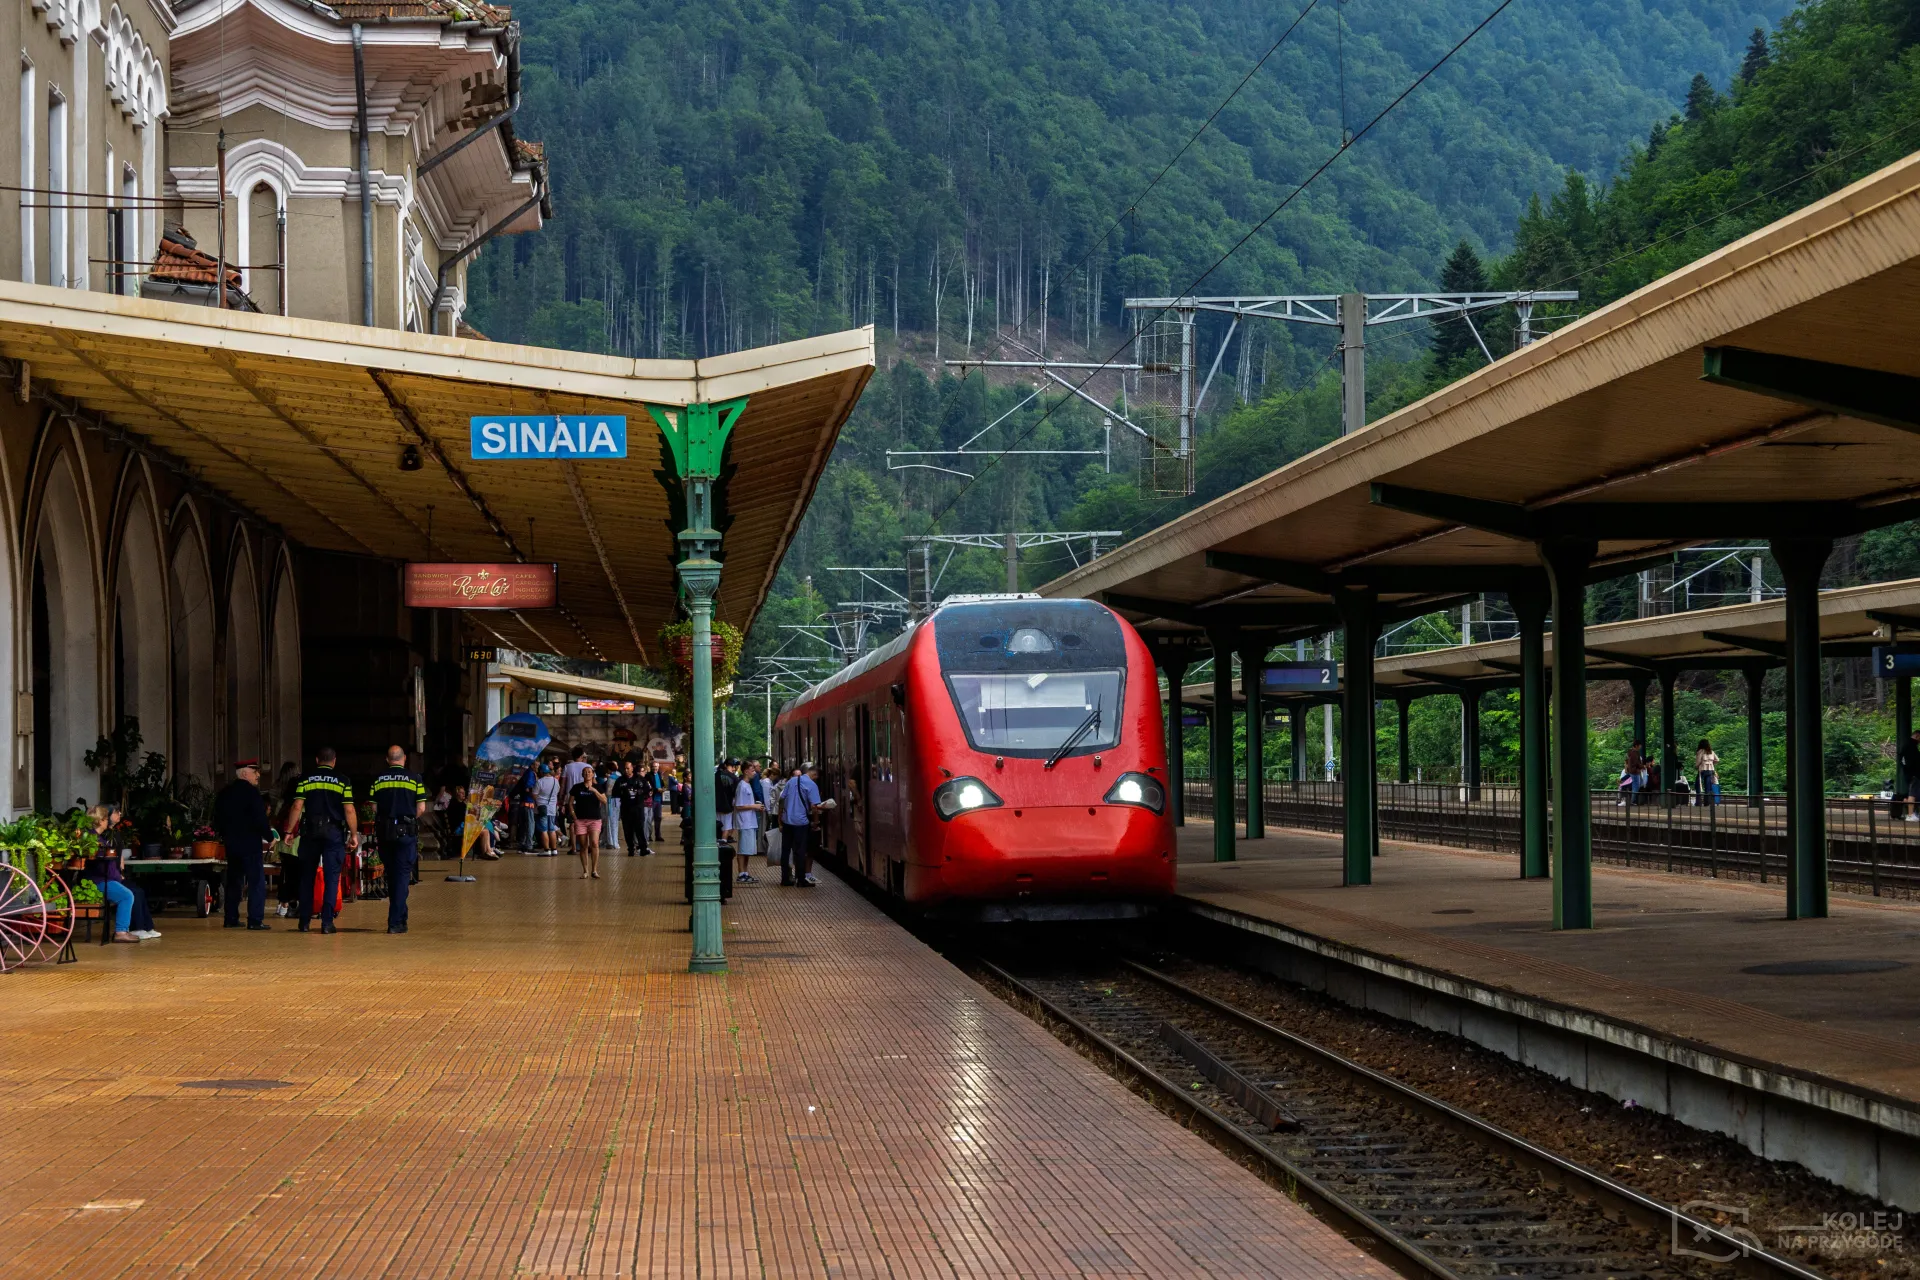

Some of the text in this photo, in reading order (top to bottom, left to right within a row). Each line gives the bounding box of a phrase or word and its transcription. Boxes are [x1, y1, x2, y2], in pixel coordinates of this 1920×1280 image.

[482, 422, 617, 453] SINAIA
[453, 576, 490, 600] Royal
[1886, 654, 1894, 669] 3
[1321, 668, 1330, 683] 2
